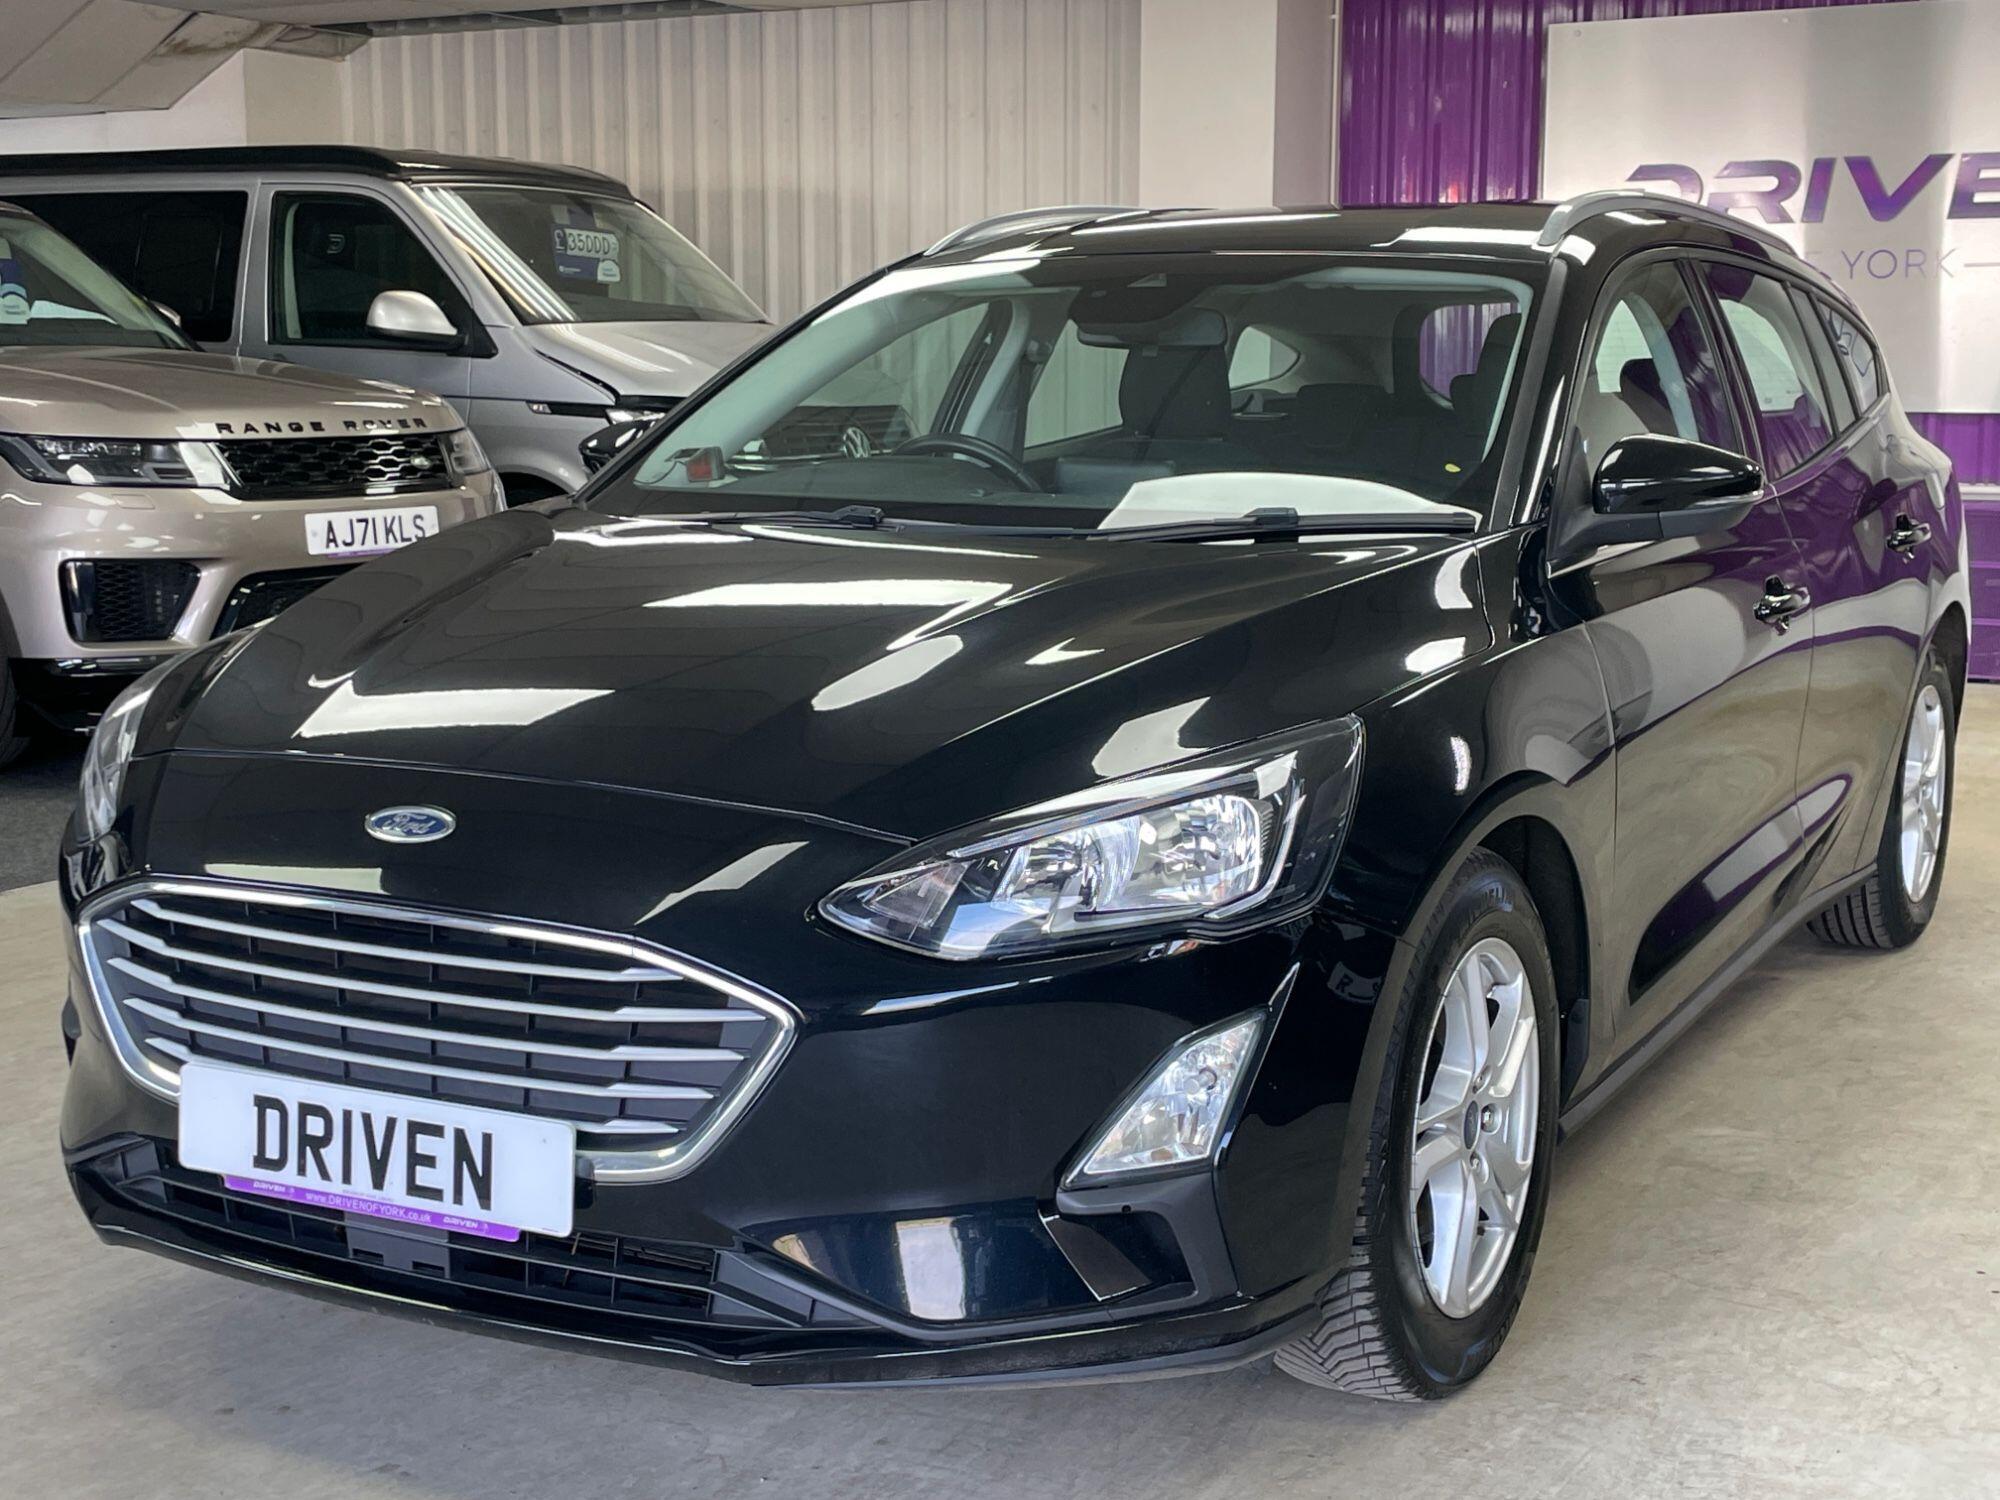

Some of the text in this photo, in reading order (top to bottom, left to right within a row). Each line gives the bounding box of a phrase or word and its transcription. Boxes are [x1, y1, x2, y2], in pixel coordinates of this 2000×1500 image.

[1841, 249, 1957, 280] YORK
[215, 418, 427, 434] RANGE ROVER
[253, 1094, 493, 1211] DRIVEN
[253, 1181, 286, 1193] DRIVEN
[305, 1192, 432, 1223] www.DRIVENOFYORK.co.uk
[442, 1216, 479, 1229] DRIVEN
